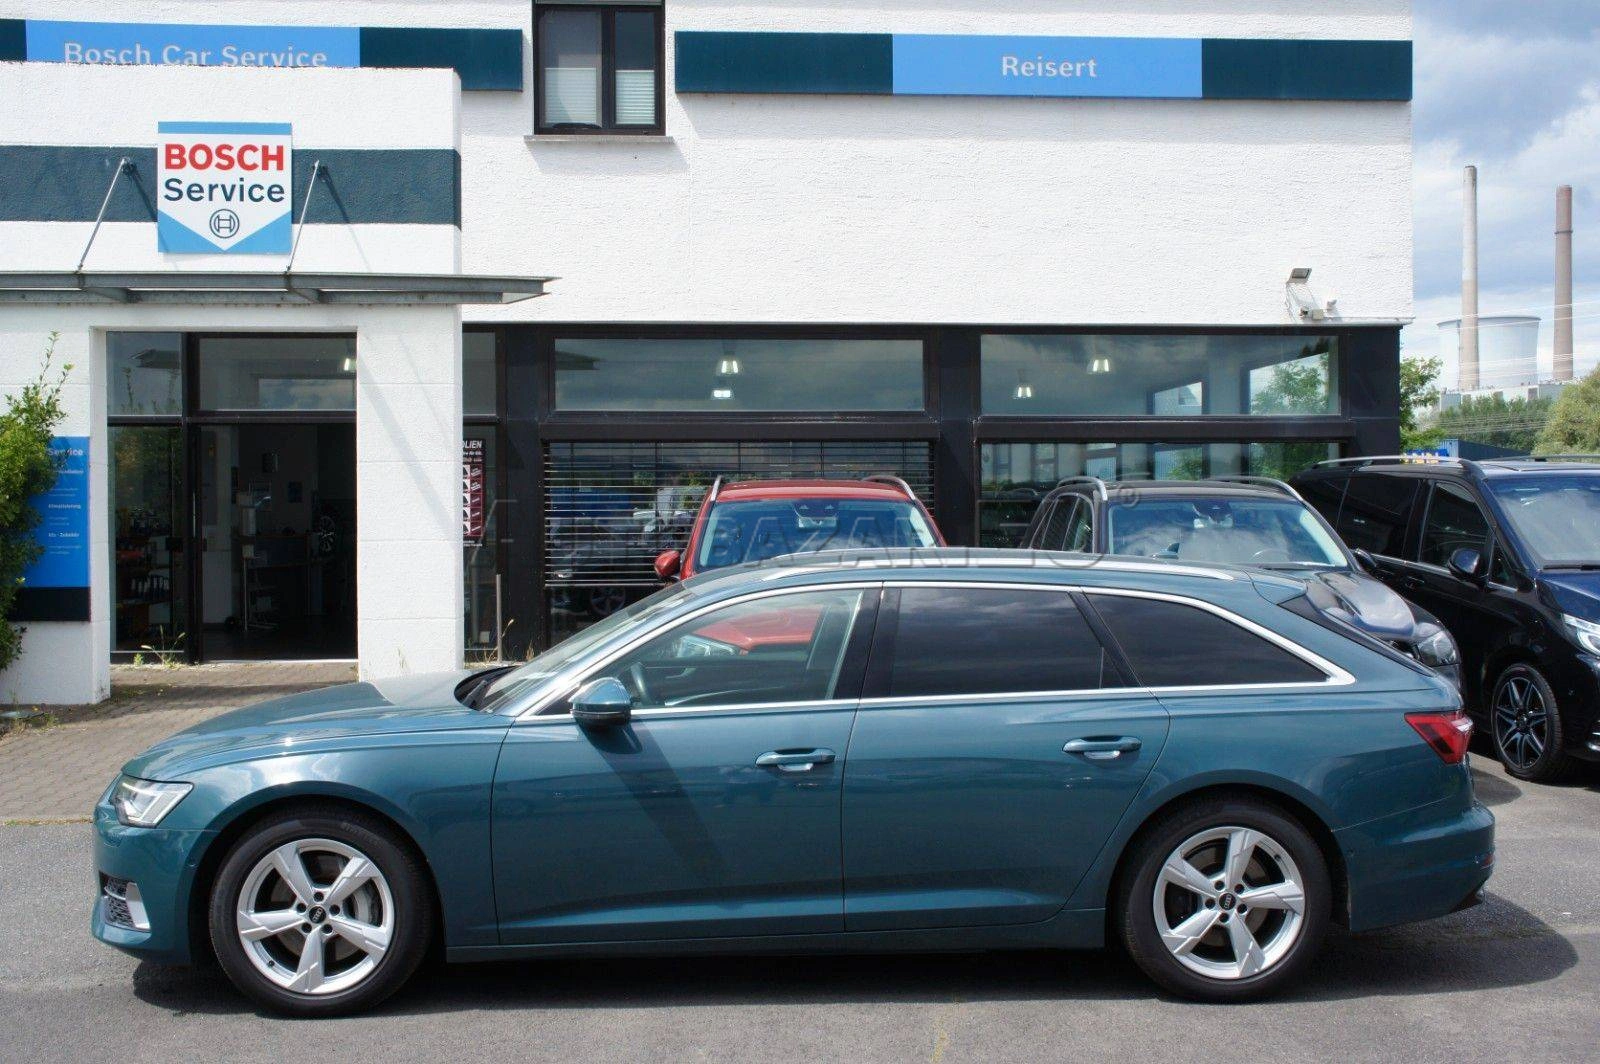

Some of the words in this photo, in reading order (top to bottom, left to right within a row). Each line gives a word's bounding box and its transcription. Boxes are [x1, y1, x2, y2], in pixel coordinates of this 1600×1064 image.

[64, 42, 150, 65] Bosch
[162, 45, 211, 66] Car
[222, 45, 328, 67] Service
[1002, 56, 1097, 77] Reisert
[165, 144, 284, 171] BOSCH
[164, 177, 285, 202] Service
